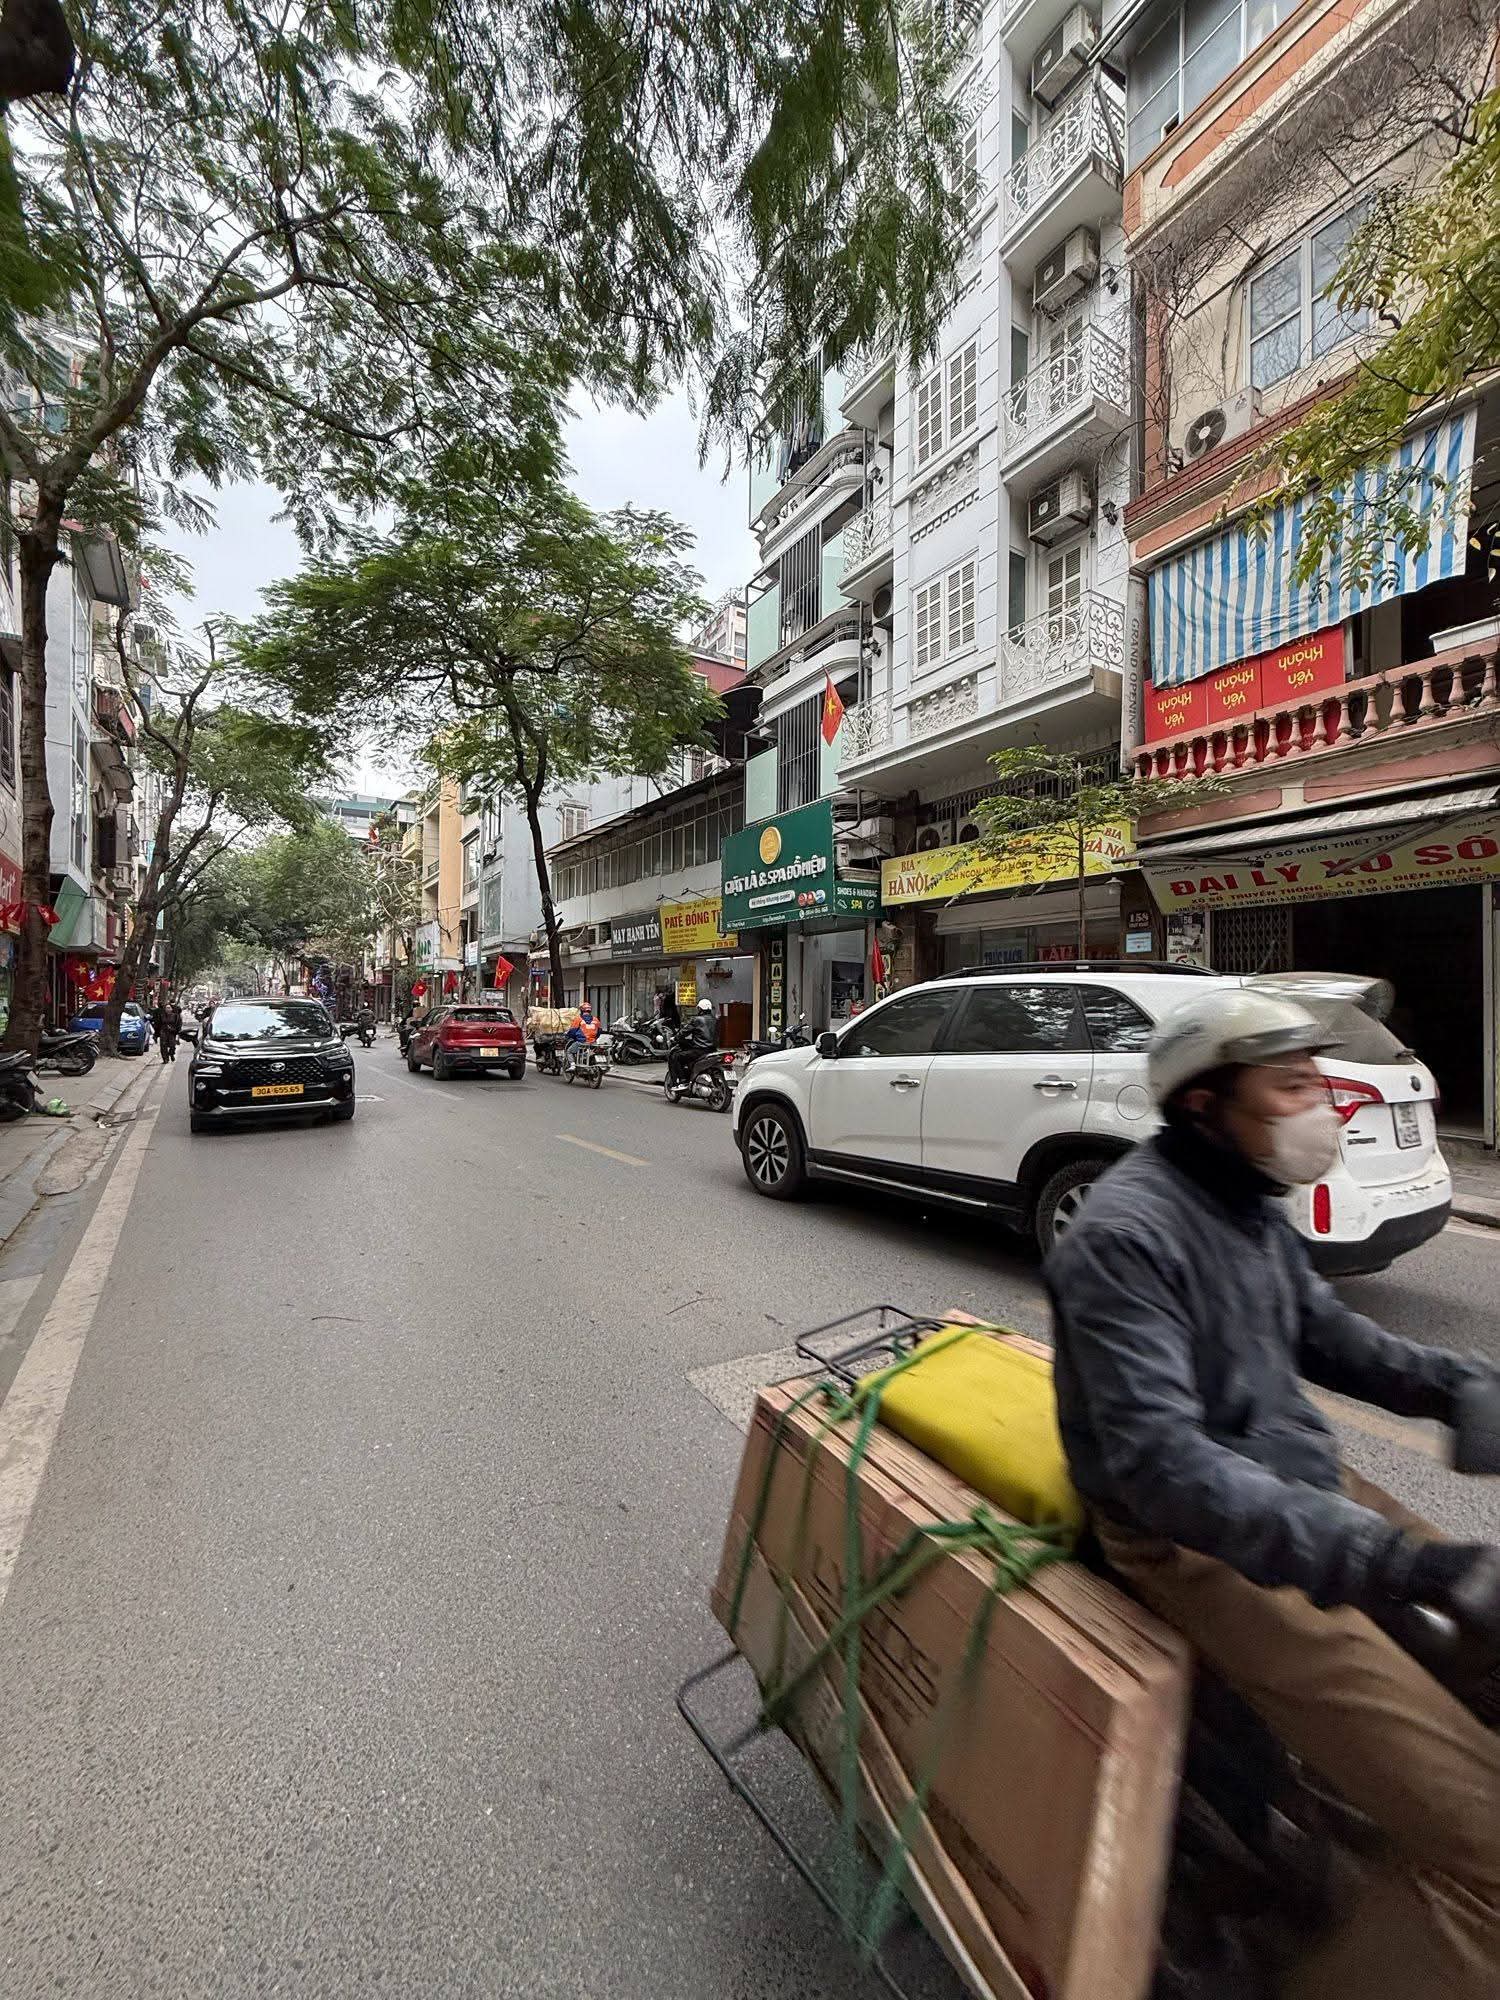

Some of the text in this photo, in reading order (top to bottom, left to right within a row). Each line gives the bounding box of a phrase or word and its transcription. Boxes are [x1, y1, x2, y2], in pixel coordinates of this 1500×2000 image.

[1129, 618, 1140, 667] GRAND
[1278, 644, 1323, 671] Khánh
[1214, 668, 1254, 692] Khánh
[1288, 668, 1314, 689] Yến
[1128, 673, 1138, 734] OPENING
[1157, 690, 1192, 714] Khánh
[1222, 690, 1246, 710] Yến
[1164, 711, 1185, 729] Yến
[901, 859, 915, 872] BIA
[1169, 874, 1239, 896] ĐẠI
[1251, 861, 1302, 887] LÝ
[1414, 829, 1499, 865] SỐ
[888, 875, 905, 896] HÀ
[851, 899, 863, 910] SPA
